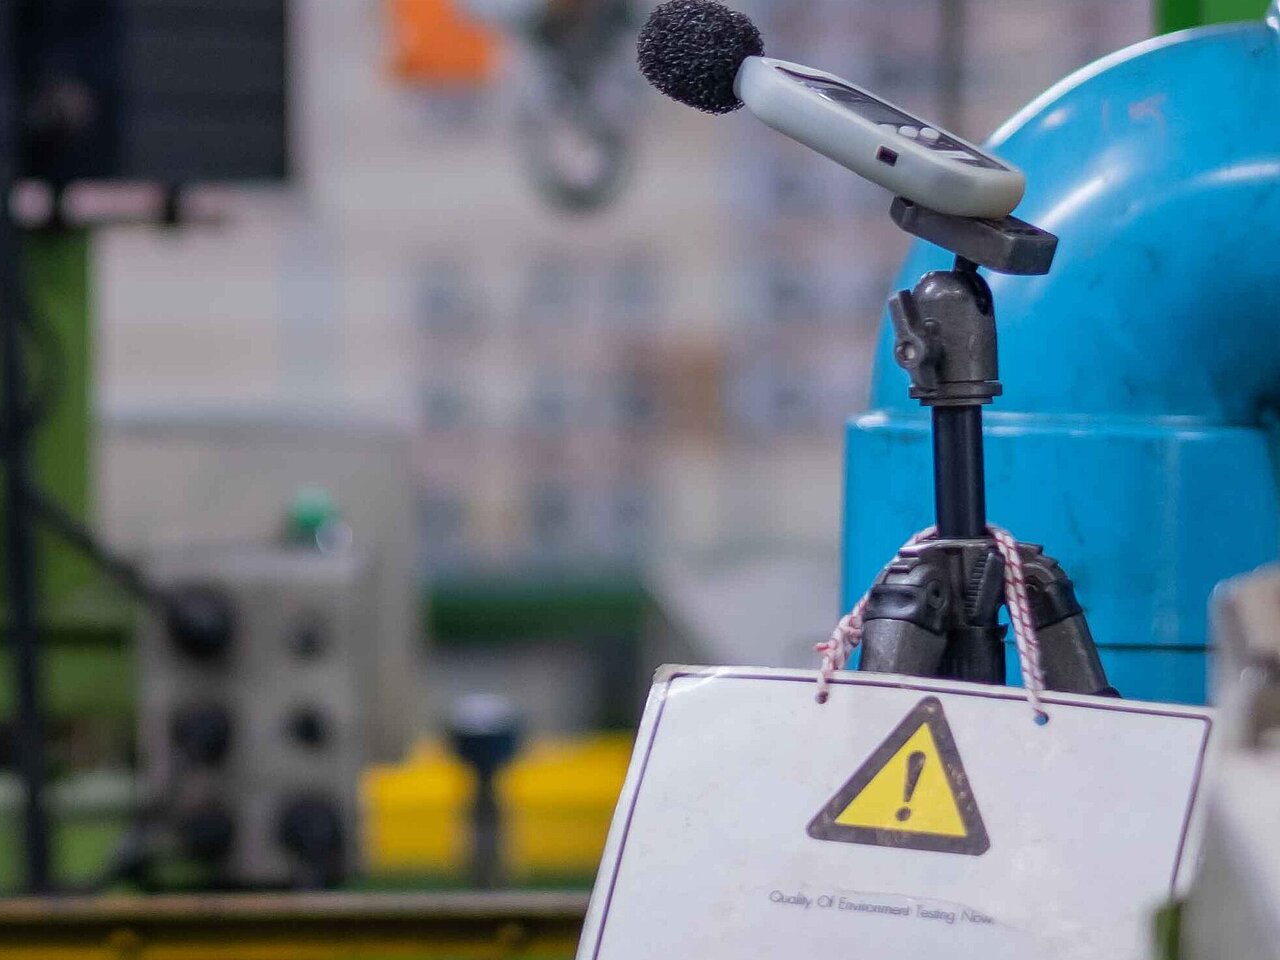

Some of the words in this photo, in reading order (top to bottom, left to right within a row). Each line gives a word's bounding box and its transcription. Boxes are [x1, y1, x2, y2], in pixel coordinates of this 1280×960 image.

[768, 890, 811, 909] Quality
[817, 894, 835, 908] Of
[916, 904, 956, 925] Testing
